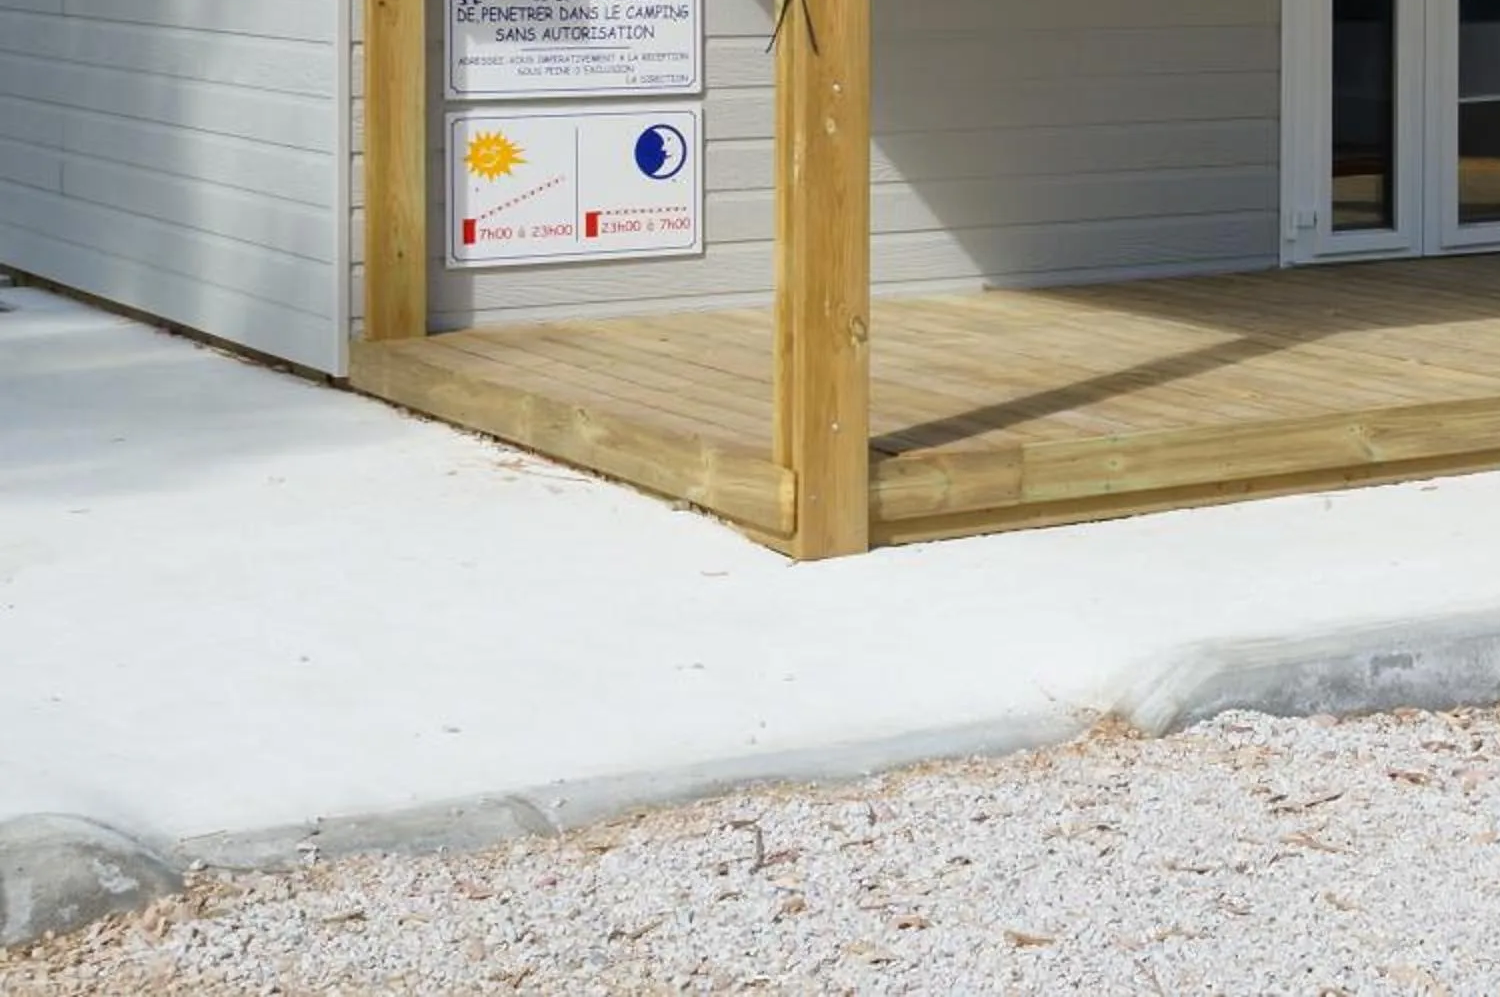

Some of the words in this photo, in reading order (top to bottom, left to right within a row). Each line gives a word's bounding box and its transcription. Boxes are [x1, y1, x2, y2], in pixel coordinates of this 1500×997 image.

[457, 6, 475, 23] DE
[481, 5, 553, 23] PENETRER
[559, 5, 599, 21] DANS
[605, 4, 621, 20] LE
[625, 4, 689, 21] CAMPING
[495, 27, 537, 42] SANS
[542, 25, 656, 41] AUTORISATION
[480, 227, 513, 241] 7h00
[532, 224, 573, 238] 23h00
[601, 219, 642, 234] 23h00
[660, 216, 691, 231] 7h00
